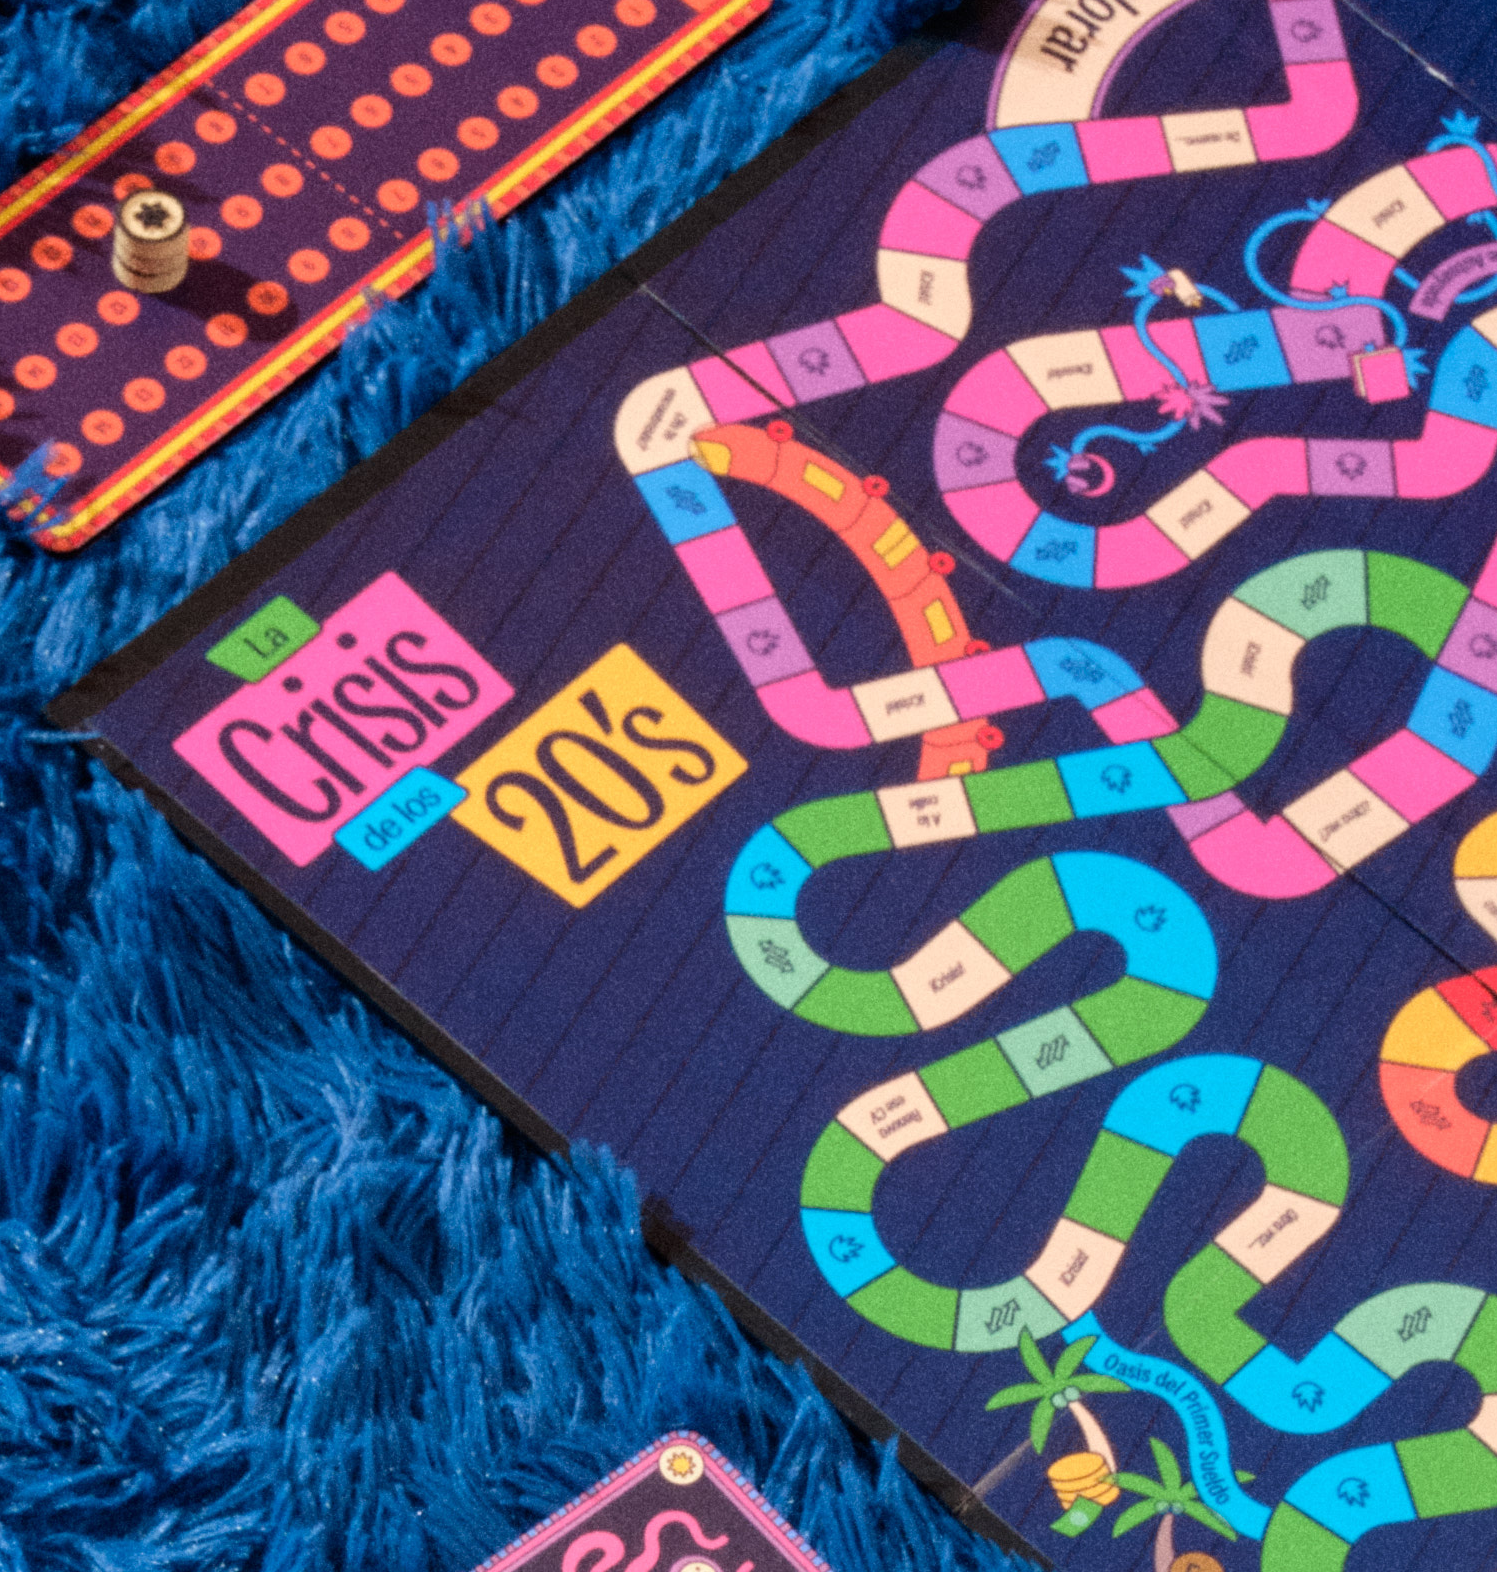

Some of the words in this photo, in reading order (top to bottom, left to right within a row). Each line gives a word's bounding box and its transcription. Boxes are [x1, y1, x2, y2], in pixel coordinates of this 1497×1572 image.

[242, 626, 291, 660] La
[216, 630, 480, 823] Crisis
[484, 688, 716, 883] 20's
[364, 814, 402, 853] de
[402, 785, 442, 832] los
[870, 1107, 887, 1125] CV
[1103, 1354, 1152, 1391] Oasis
[1156, 1366, 1188, 1402] del
[1185, 1390, 1214, 1447] Primer
[1196, 1447, 1231, 1506] Sueldo
